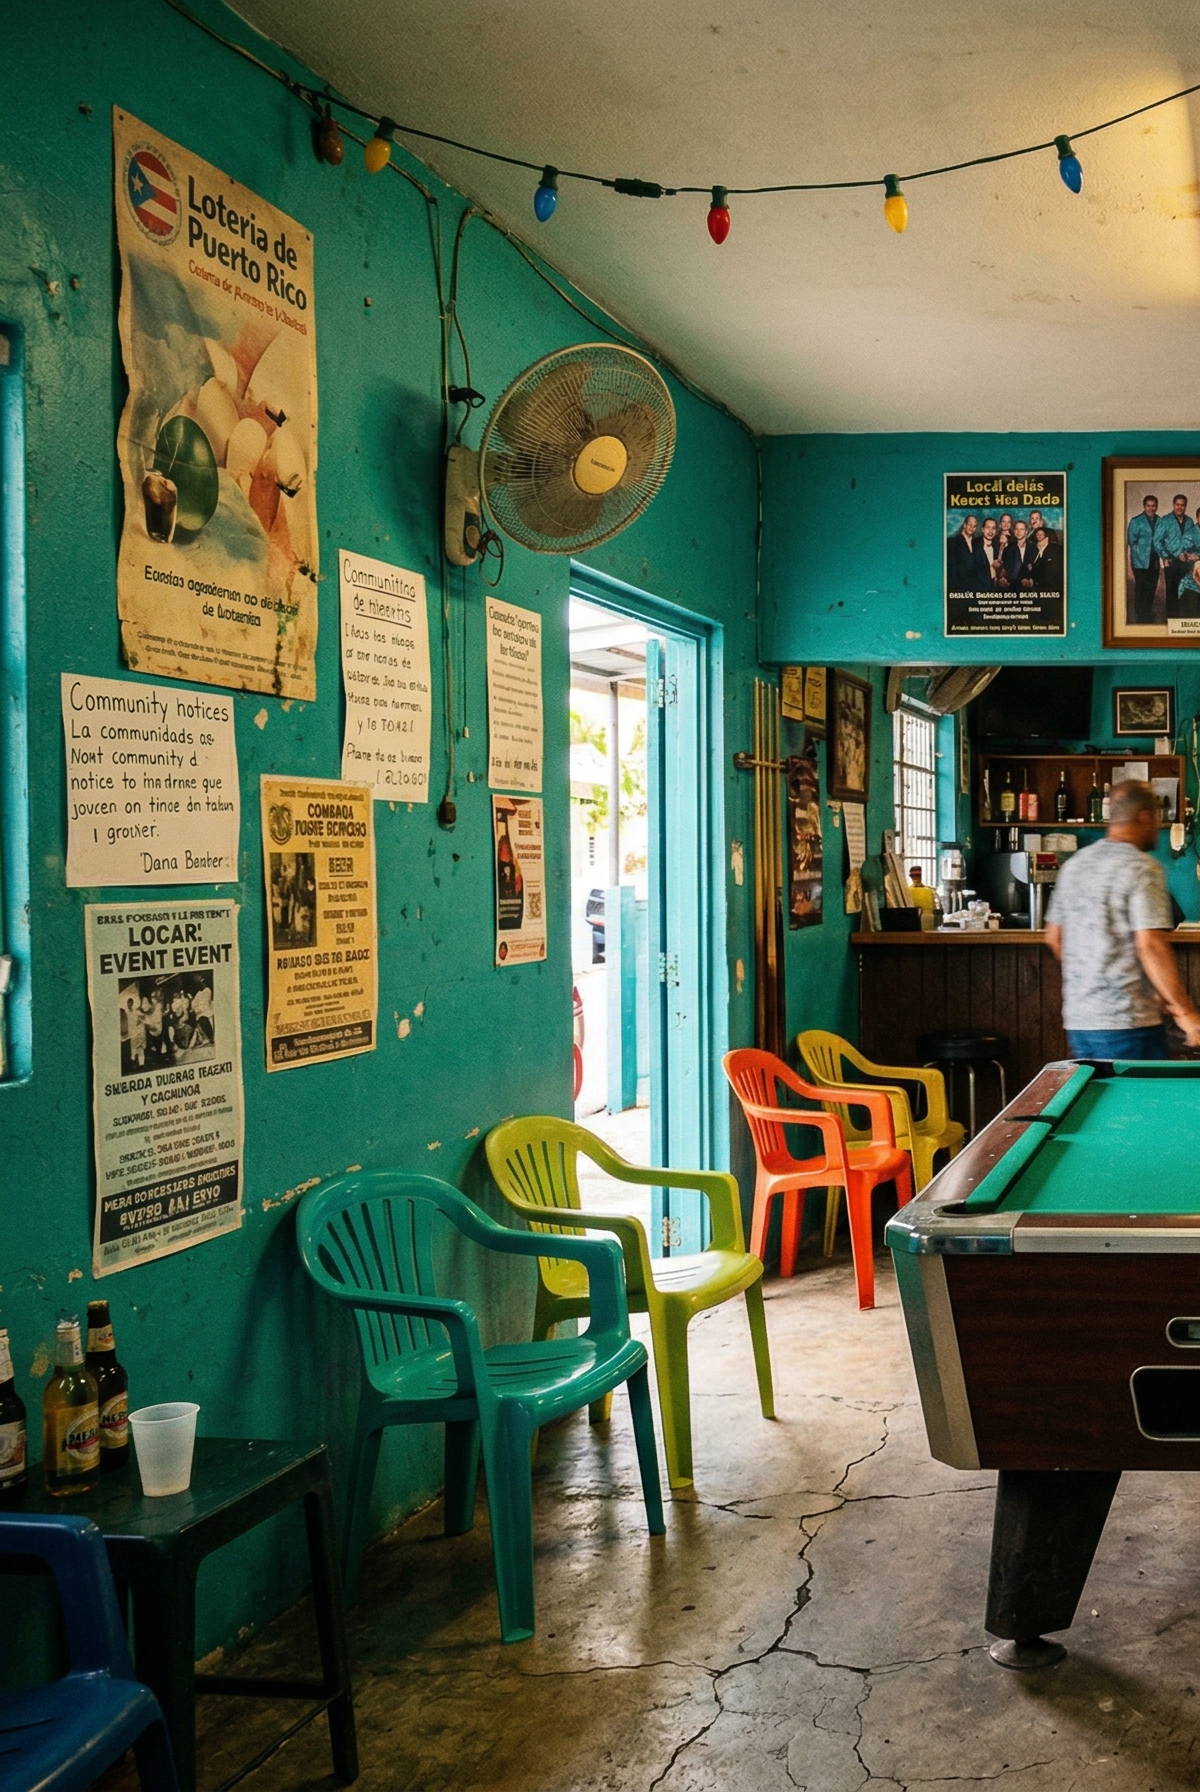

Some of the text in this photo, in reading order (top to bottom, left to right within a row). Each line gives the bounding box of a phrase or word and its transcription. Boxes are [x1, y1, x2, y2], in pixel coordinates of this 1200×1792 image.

[188, 215, 261, 284] Puerto
[267, 261, 307, 311] Rico
[274, 233, 298, 271] de
[70, 682, 168, 724] Community
[71, 719, 91, 739] La
[112, 749, 184, 769] community
[70, 771, 114, 791] notice
[122, 771, 136, 790] to
[100, 943, 233, 975] EVENT EVENT
